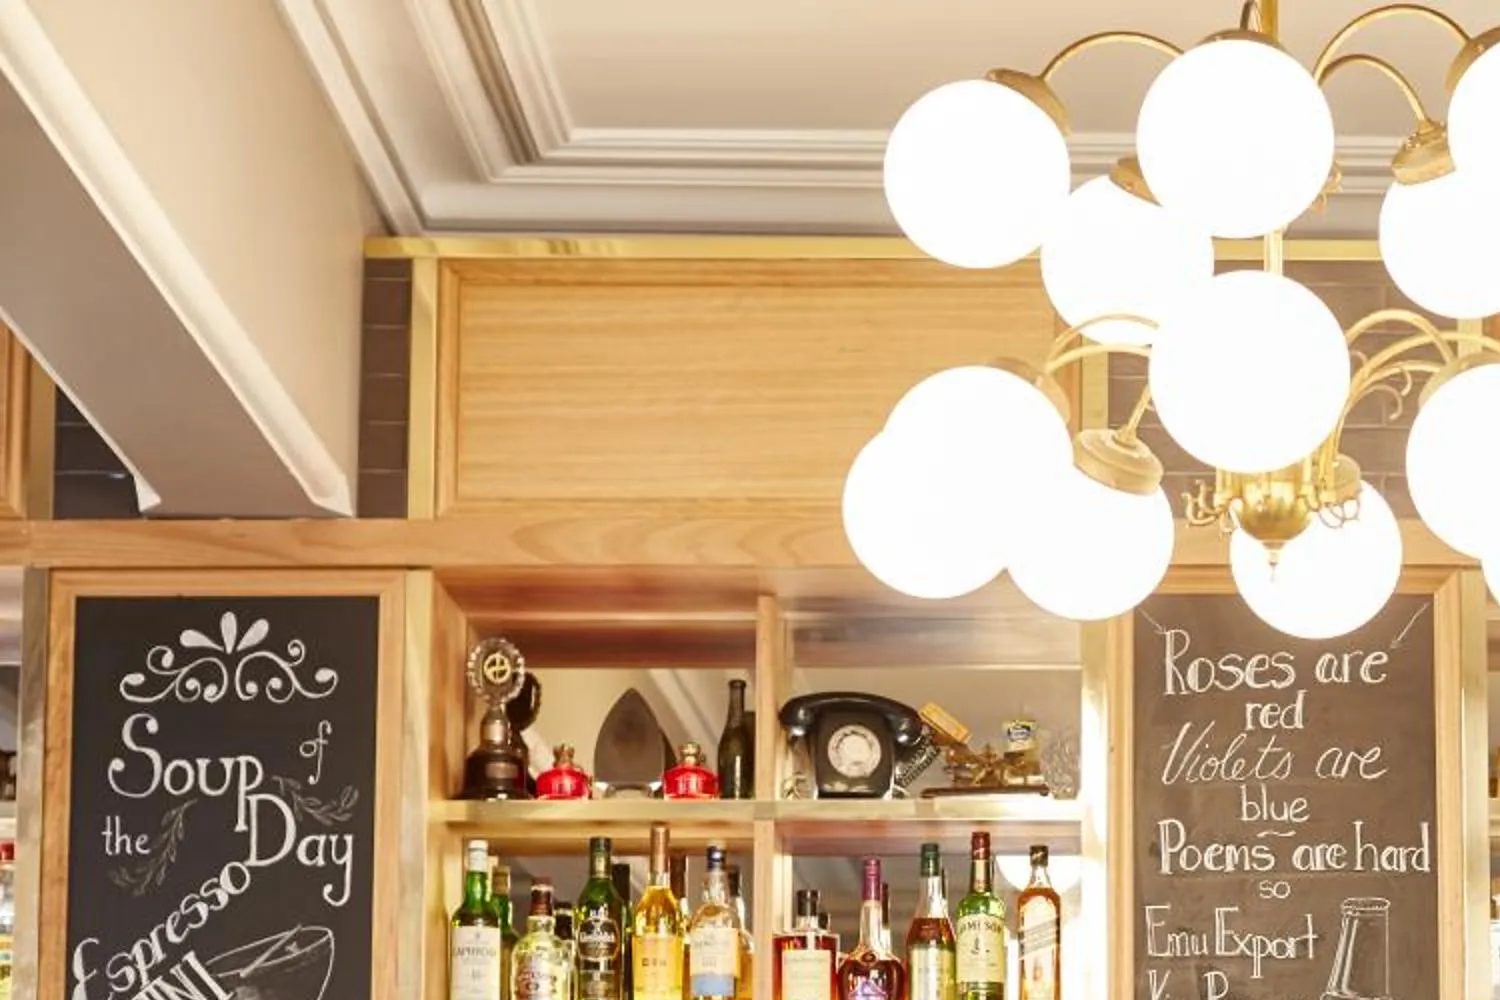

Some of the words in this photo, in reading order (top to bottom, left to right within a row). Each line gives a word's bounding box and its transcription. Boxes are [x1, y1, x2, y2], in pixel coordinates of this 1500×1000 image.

[1164, 629, 1296, 694] Roses
[1315, 650, 1389, 684] are
[1245, 689, 1308, 730] red
[107, 714, 264, 832] Soup
[299, 720, 332, 784] of
[1161, 721, 1295, 785] Violets
[1315, 746, 1390, 779] are
[101, 816, 151, 855] the
[1240, 784, 1310, 823] blue
[247, 793, 356, 906] Day
[1157, 819, 1275, 875] Poems
[1292, 842, 1347, 871] are
[1352, 820, 1430, 872] hard
[1259, 880, 1291, 899] so
[1144, 905, 1208, 958] Emu
[1215, 907, 1318, 978] Export
